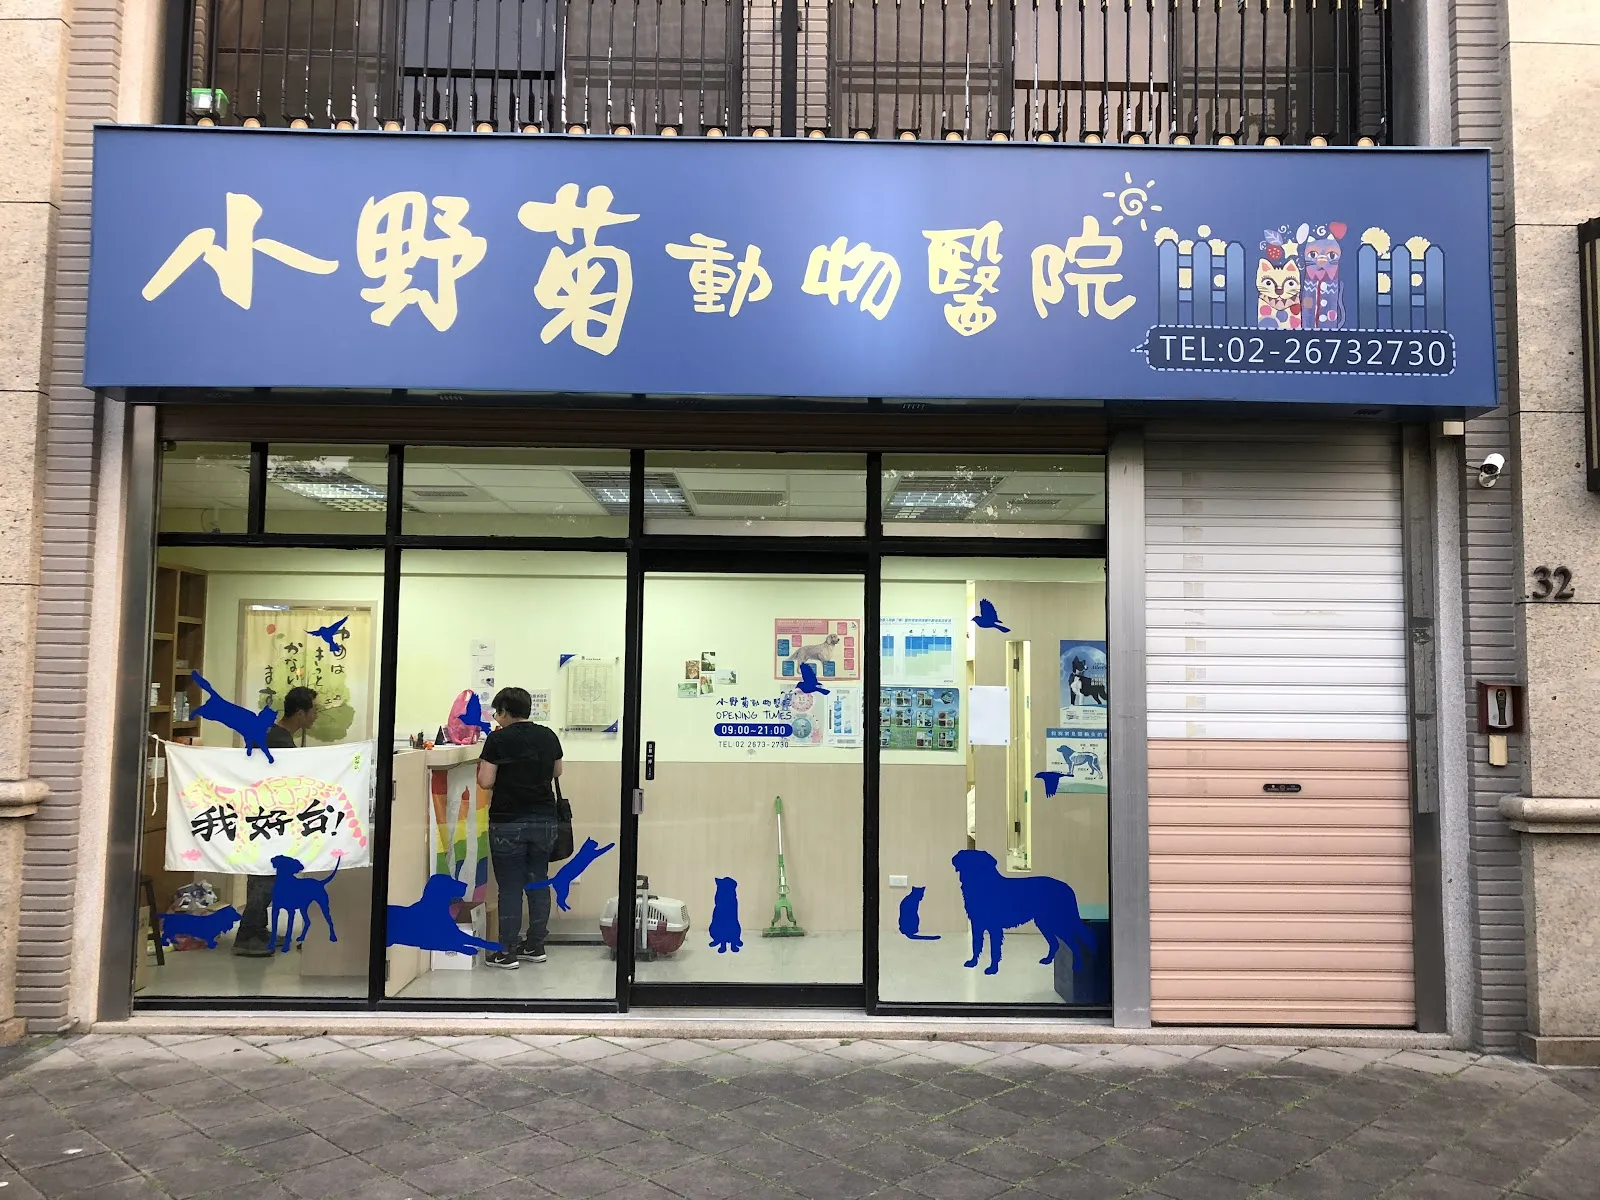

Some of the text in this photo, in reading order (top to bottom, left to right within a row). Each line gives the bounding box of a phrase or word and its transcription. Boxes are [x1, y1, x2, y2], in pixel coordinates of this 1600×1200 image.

[142, 183, 1136, 356] 小野菊動物醫院
[1159, 335, 1446, 367] TEL:02-26732730
[1532, 565, 1575, 600] 32
[716, 710, 758, 720] OPENING
[721, 725, 786, 735] 09:00~21:00
[191, 799, 345, 842] 我好台!
